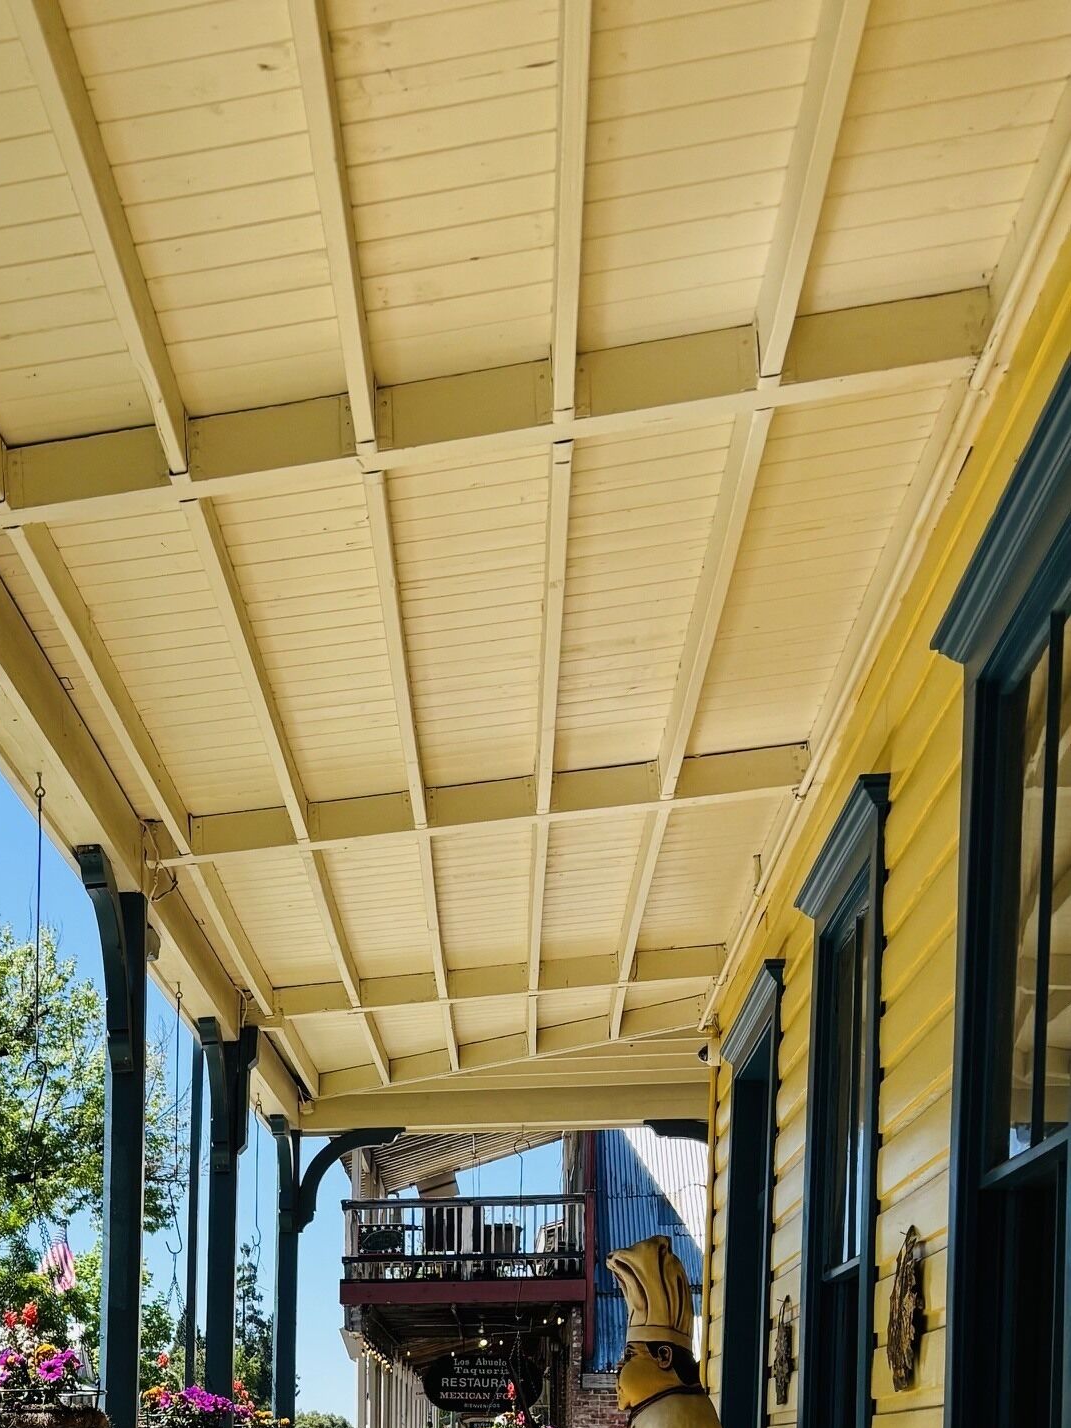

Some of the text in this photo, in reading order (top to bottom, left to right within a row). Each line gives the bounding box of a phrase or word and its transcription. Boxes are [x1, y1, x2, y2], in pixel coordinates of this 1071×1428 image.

[454, 1358, 470, 1367] Los
[441, 1377, 524, 1389] RESTAURA
[439, 1391, 491, 1400] MEXICAN
